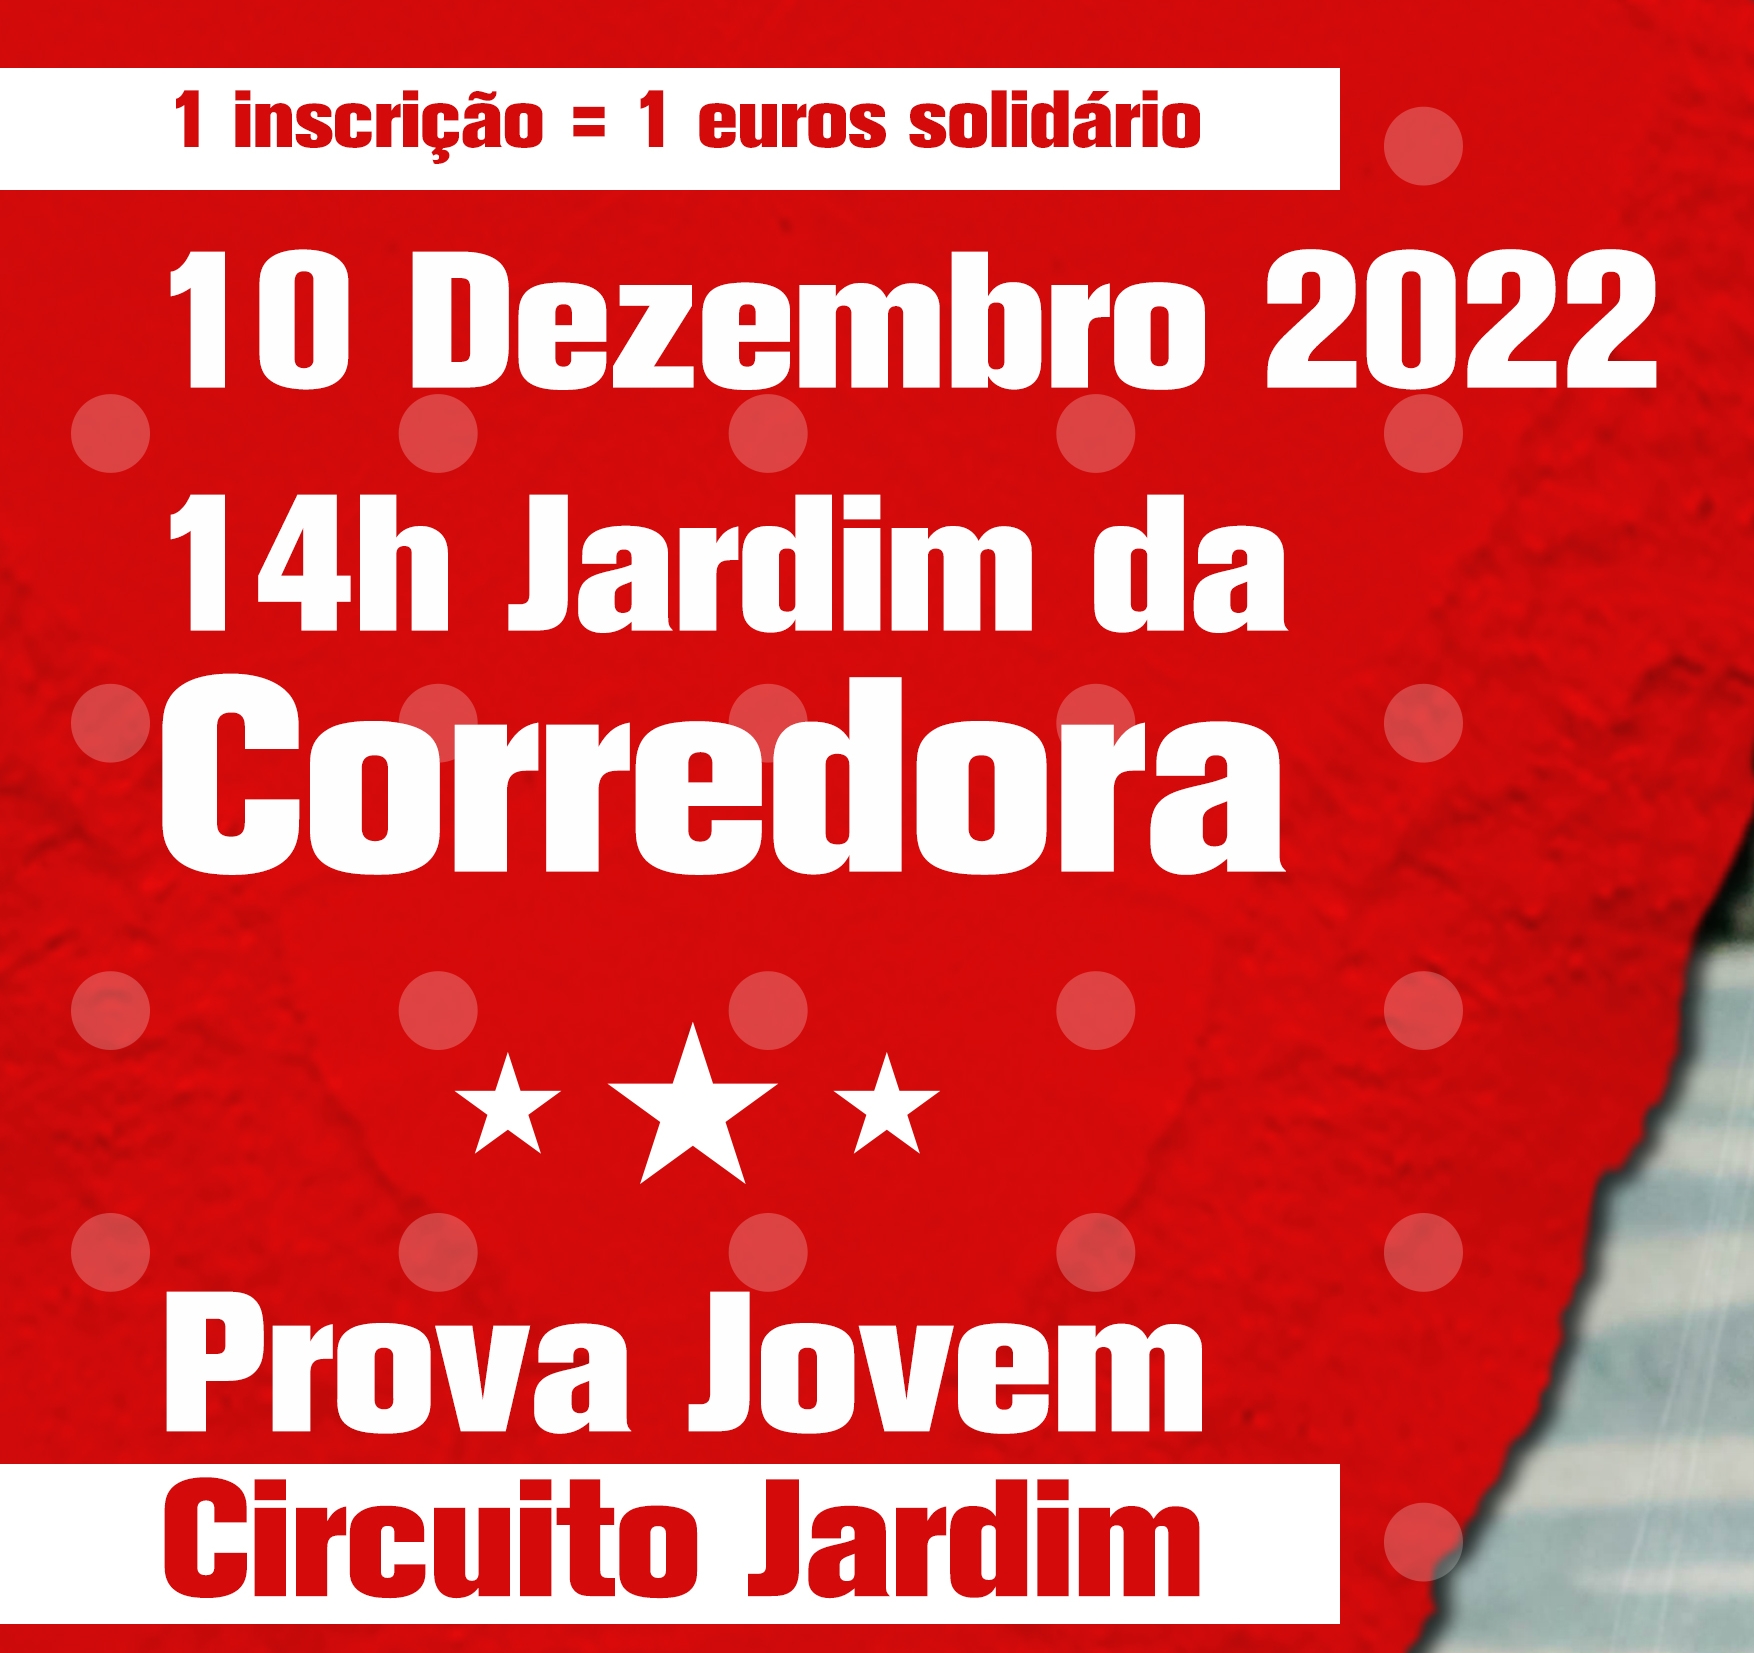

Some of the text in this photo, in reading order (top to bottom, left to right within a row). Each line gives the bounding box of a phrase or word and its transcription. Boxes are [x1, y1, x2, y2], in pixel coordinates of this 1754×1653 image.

[175, 90, 199, 147] 1
[235, 89, 543, 164] inscrição
[640, 90, 664, 147] 1
[699, 102, 886, 149] euros
[909, 89, 1201, 149] solidário
[170, 248, 1658, 391] 10 Dezembro 2022
[170, 495, 1289, 634] 14h Jardim da
[162, 673, 1287, 876] Corredora
[166, 1291, 1203, 1435] Prova Jovem
[164, 1477, 1200, 1599] Circuito Jardim
